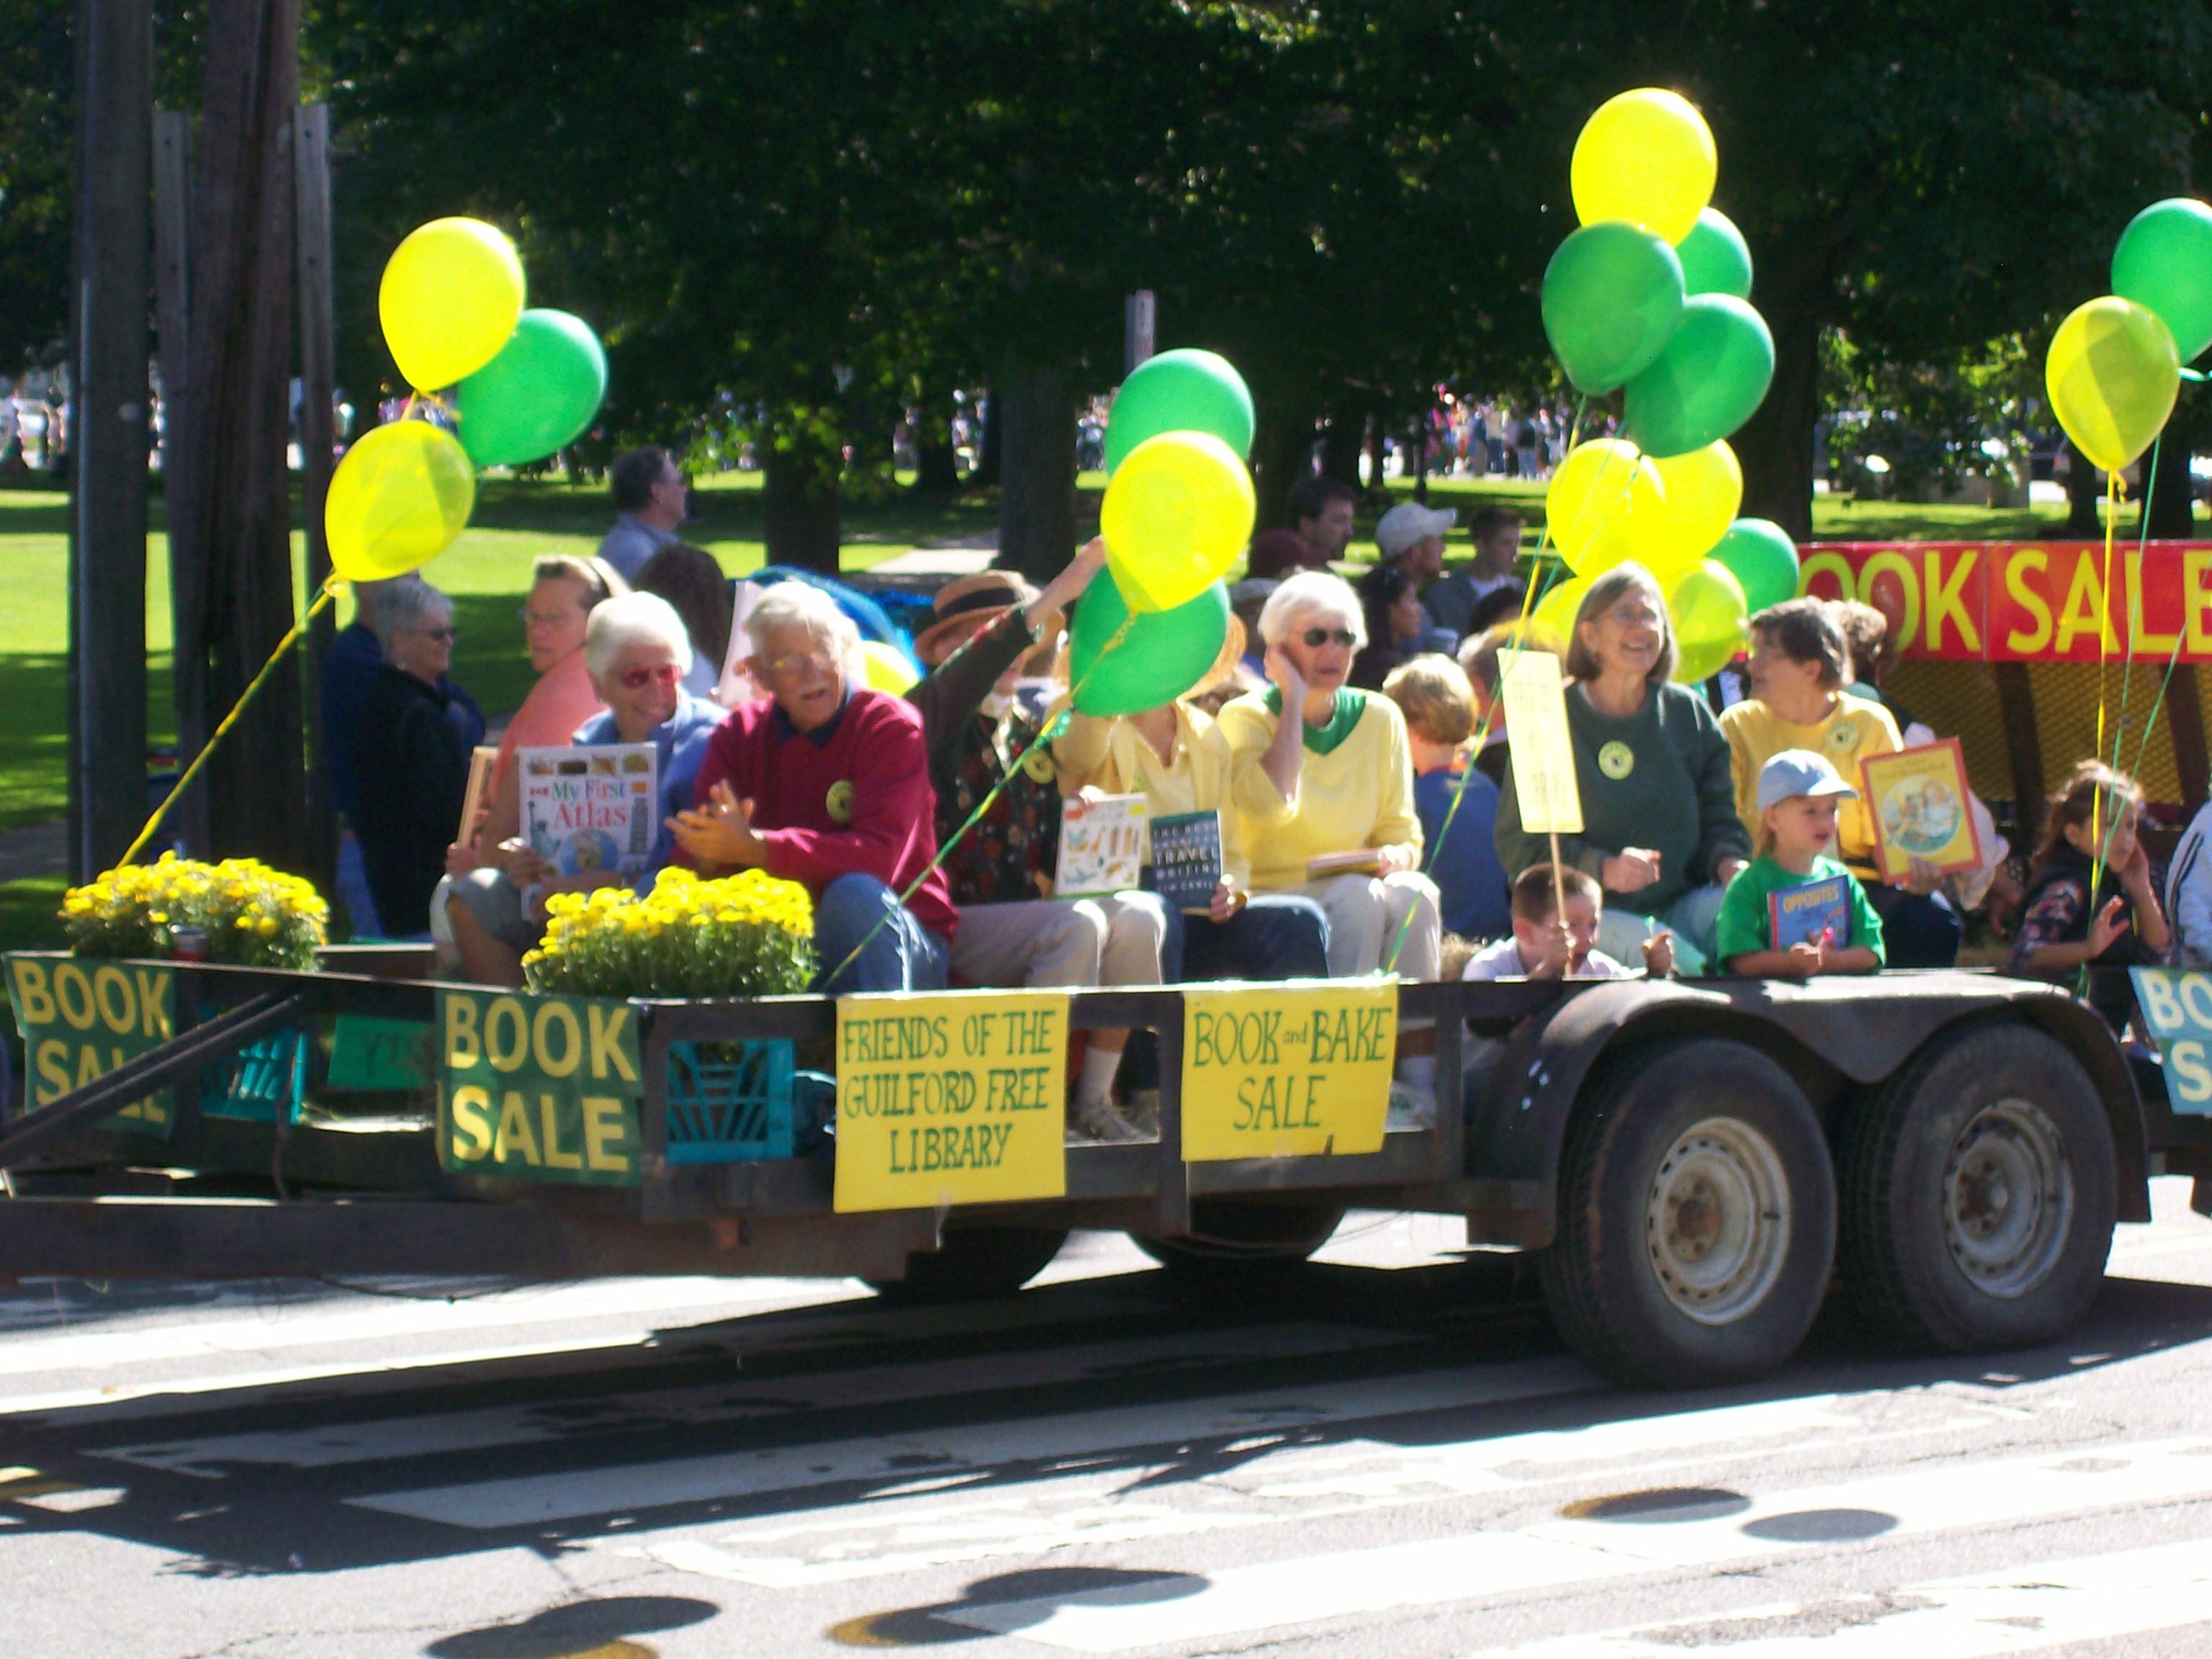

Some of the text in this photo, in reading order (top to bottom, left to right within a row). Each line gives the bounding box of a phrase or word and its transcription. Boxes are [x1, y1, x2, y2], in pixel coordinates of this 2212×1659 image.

[1799, 548, 2212, 654] OOK SALE
[552, 779, 625, 804] My First
[554, 801, 627, 830] Atlas
[1156, 848, 1220, 865] TRAVEL
[1156, 863, 1220, 879] WRITING
[1782, 884, 1840, 914] OPPOSITES
[12, 960, 174, 1040] BOOK
[2139, 971, 2212, 1030] BO
[445, 994, 638, 1082] BOOK
[843, 1010, 1056, 1063] FRIENDS OF THE
[1193, 1007, 1393, 1068] BOOK and BAKE
[36, 1038, 166, 1123] SA
[844, 1067, 1049, 1119] GUILFORD FREE
[2170, 1040, 2212, 1102] S
[451, 1085, 630, 1172] SALE
[1233, 1075, 1326, 1130] SALE
[889, 1123, 1012, 1174] LIBRARY
